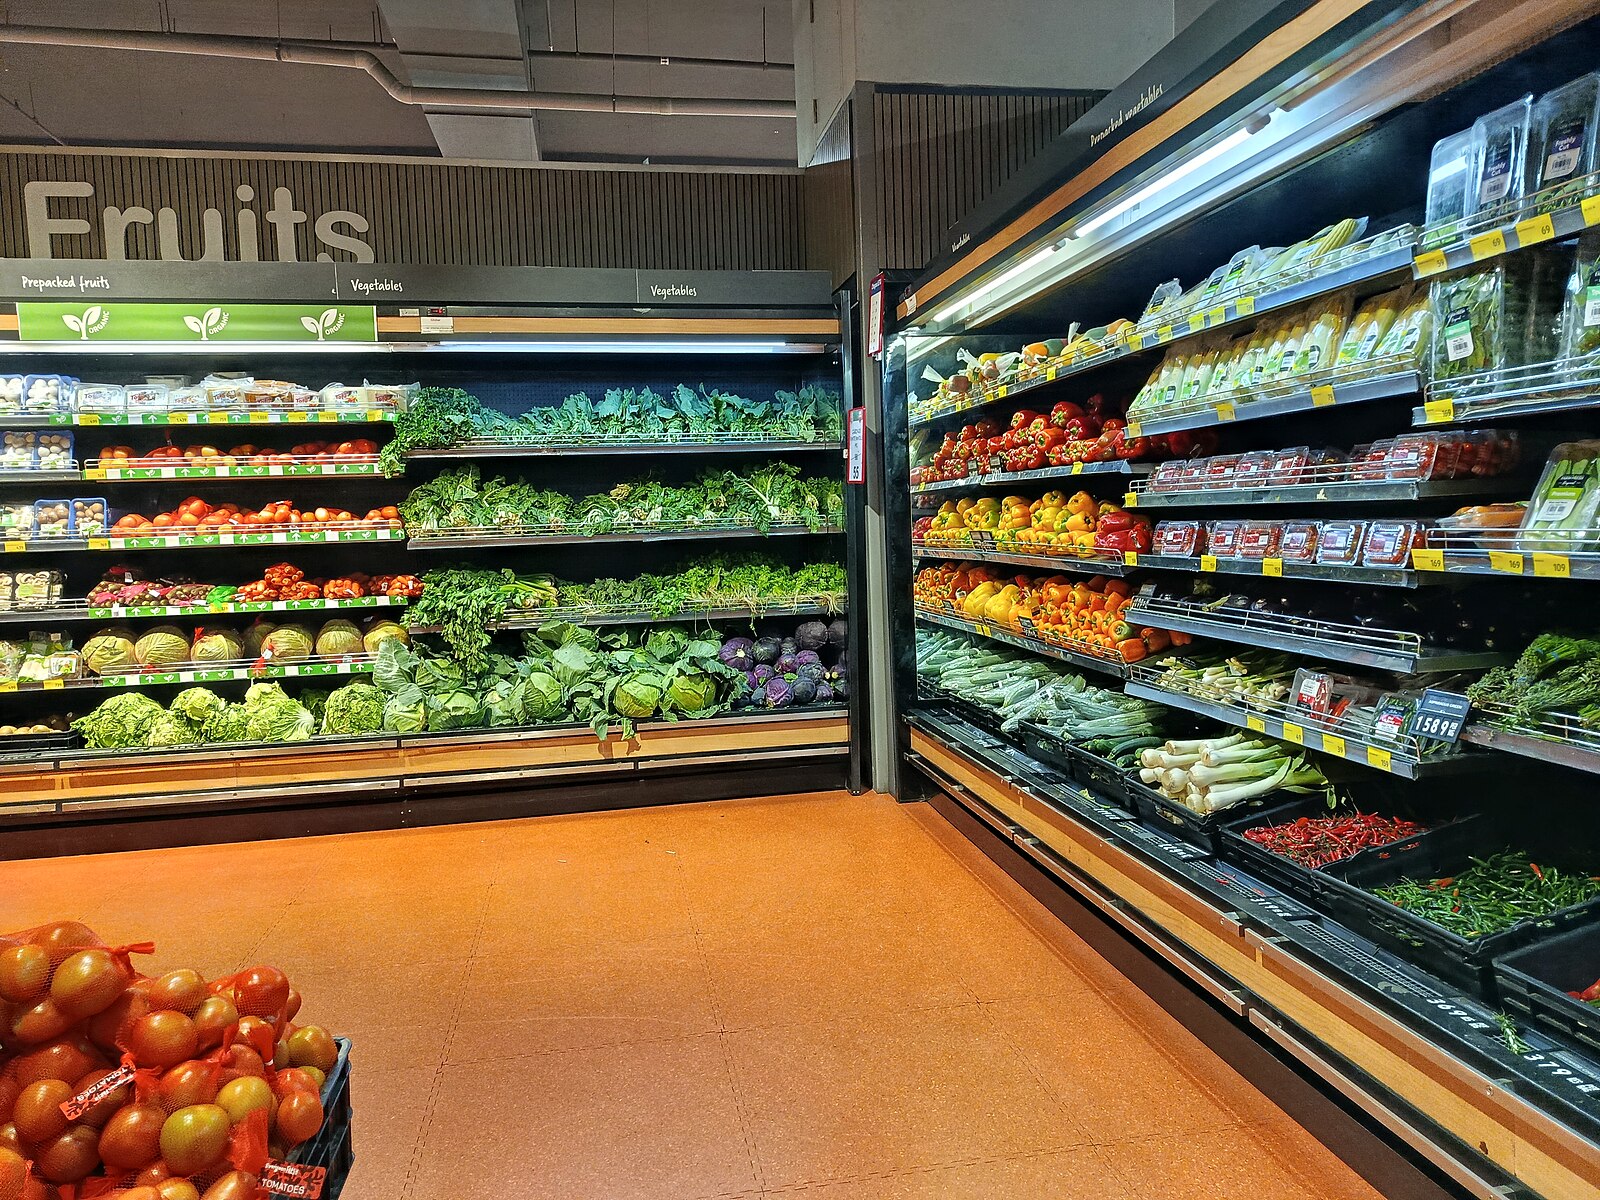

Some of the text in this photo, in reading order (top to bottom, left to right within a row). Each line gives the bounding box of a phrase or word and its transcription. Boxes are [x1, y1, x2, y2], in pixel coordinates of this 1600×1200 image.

[24, 181, 375, 263] Fruits
[1541, 225, 1551, 235] 69
[1492, 237, 1501, 247] 69
[1437, 258, 1445, 268] 59
[21, 275, 110, 293] Prepacked fruits
[350, 279, 403, 294] Vegetables
[650, 284, 697, 300] Vegetables
[88, 310, 110, 334] ORGANIC
[208, 311, 230, 335] ORGANIC
[324, 313, 346, 336] ORGANIC
[1509, 560, 1520, 569] 169
[1553, 563, 1566, 572] 109
[1415, 715, 1450, 736] 1589
[1426, 998, 1468, 1016] 369
[1523, 1053, 1572, 1076] 379
[77, 1067, 128, 1102] TOMATOES
[262, 1178, 305, 1195] TOMATOES
